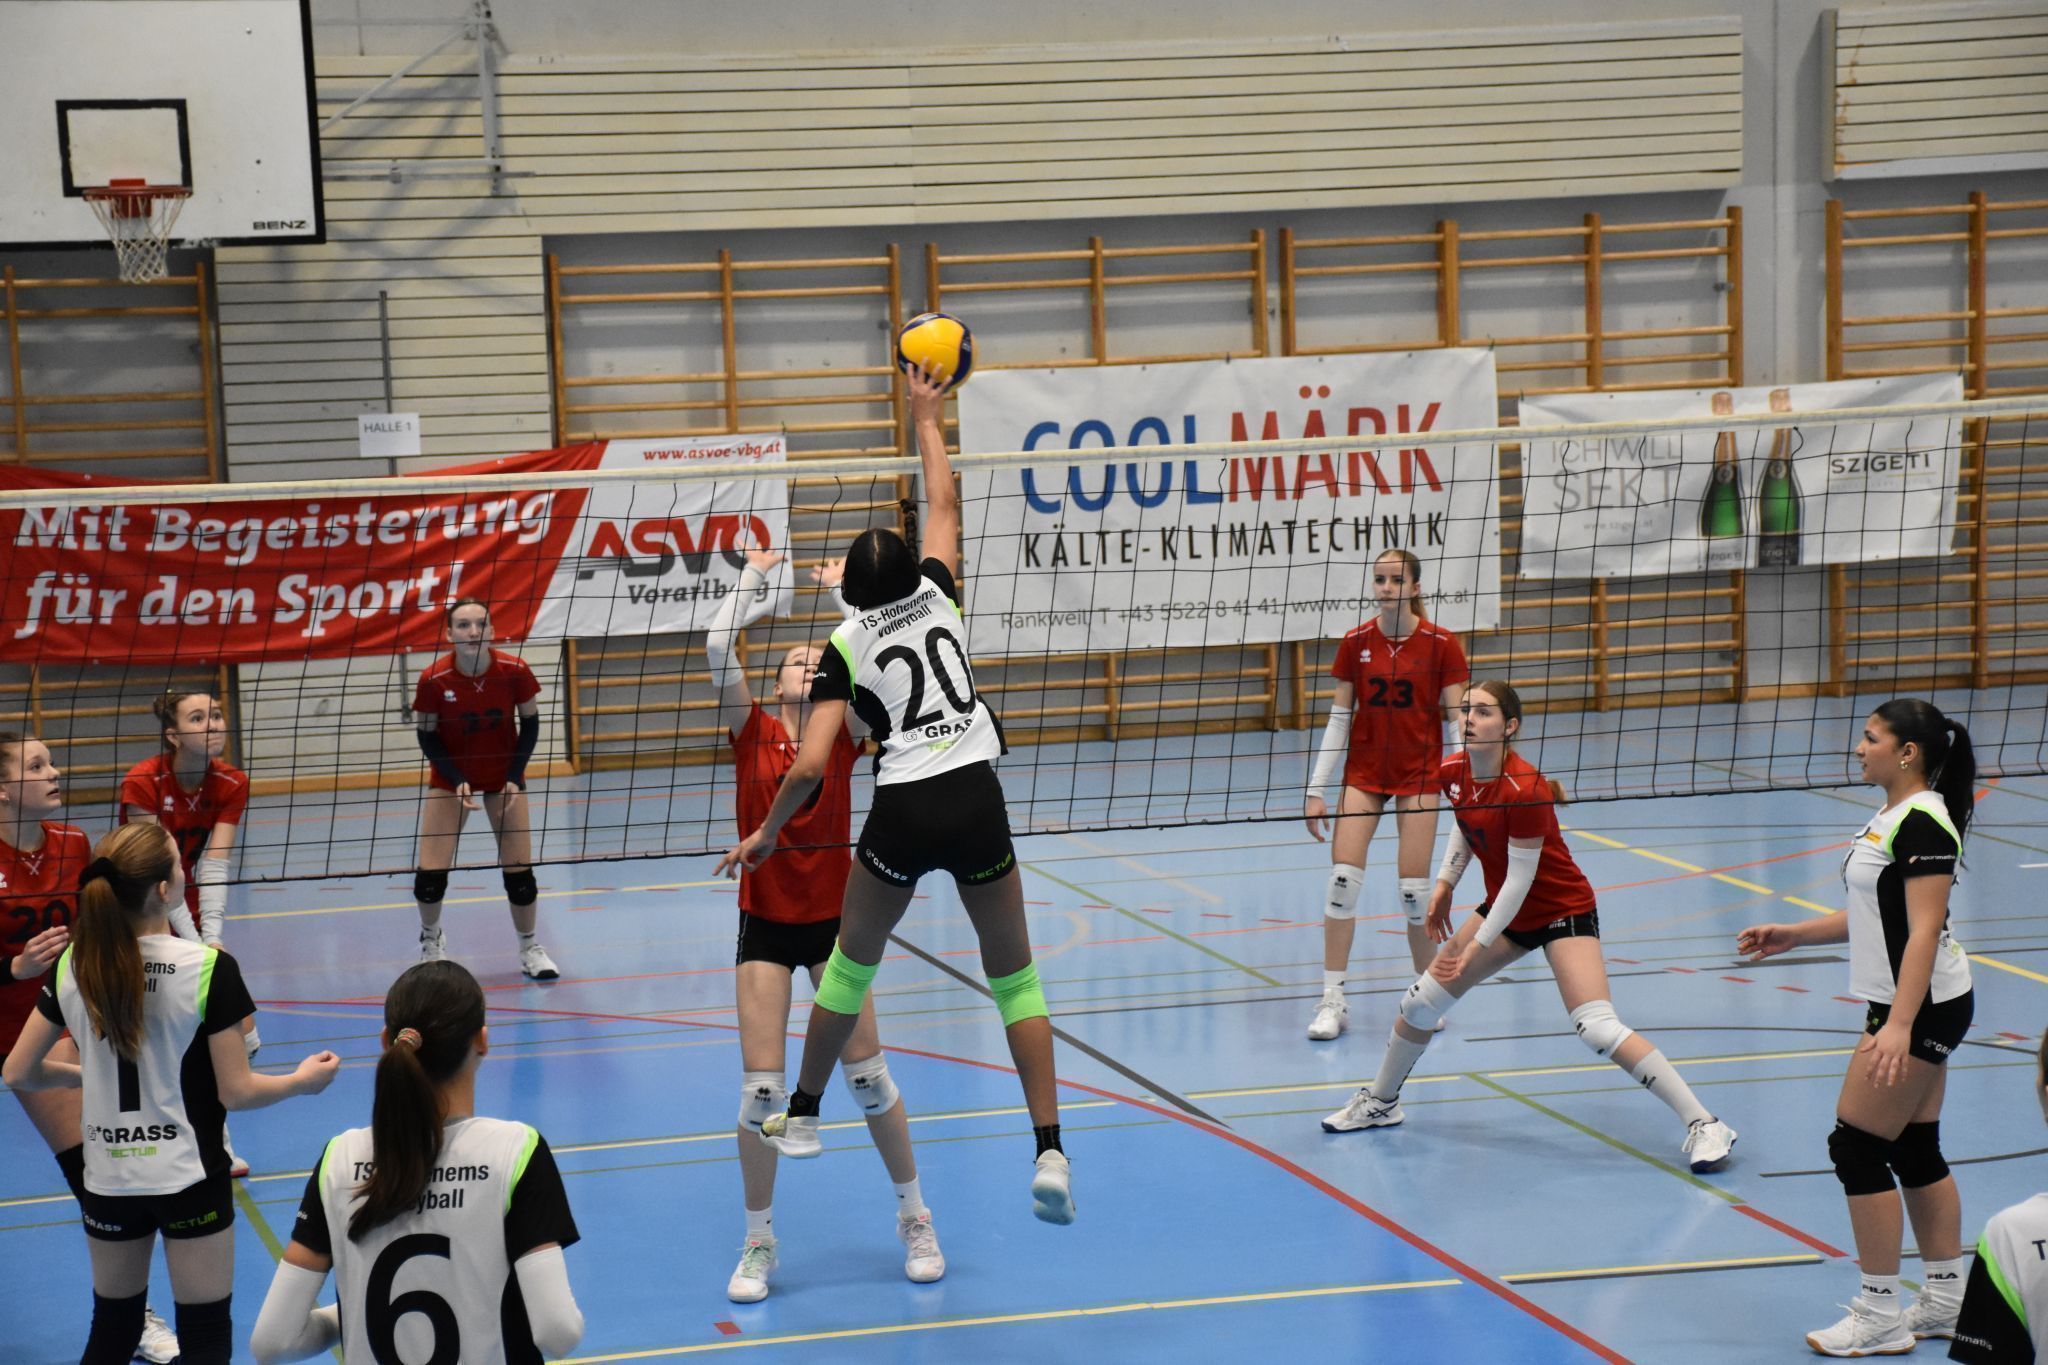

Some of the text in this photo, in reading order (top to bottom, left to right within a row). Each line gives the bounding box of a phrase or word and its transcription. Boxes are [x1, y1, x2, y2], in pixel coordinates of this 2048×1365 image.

[253, 220, 307, 231] BENZ
[363, 421, 412, 434] HALLE 1
[643, 441, 781, 461] www.asvoe-vbg.at
[1020, 385, 1444, 514] COOLMÄRK
[1552, 437, 1682, 463] ICH WILL
[1831, 453, 1931, 474] SZIGETI
[1552, 466, 1683, 512] SEKT
[13, 492, 556, 567] Mit Begeisterung
[1024, 512, 1444, 568] KÄLTE-KLIMATECHNIK
[14, 559, 465, 640] für den Sport!
[628, 578, 769, 605] Vorarlbg
[859, 588, 938, 631] TS-Hohenems
[1098, 607, 1111, 625] T
[1118, 604, 1154, 623] +43
[1160, 601, 1209, 621] 5522
[1215, 600, 1228, 618] 8
[1233, 598, 1252, 617] 41
[874, 627, 977, 733] 20
[1367, 677, 1414, 709] 23
[7, 899, 71, 945] 20
[1861, 1284, 1893, 1295] FILA
[1927, 1272, 1959, 1280] FILA
[365, 1233, 461, 1365] 6
